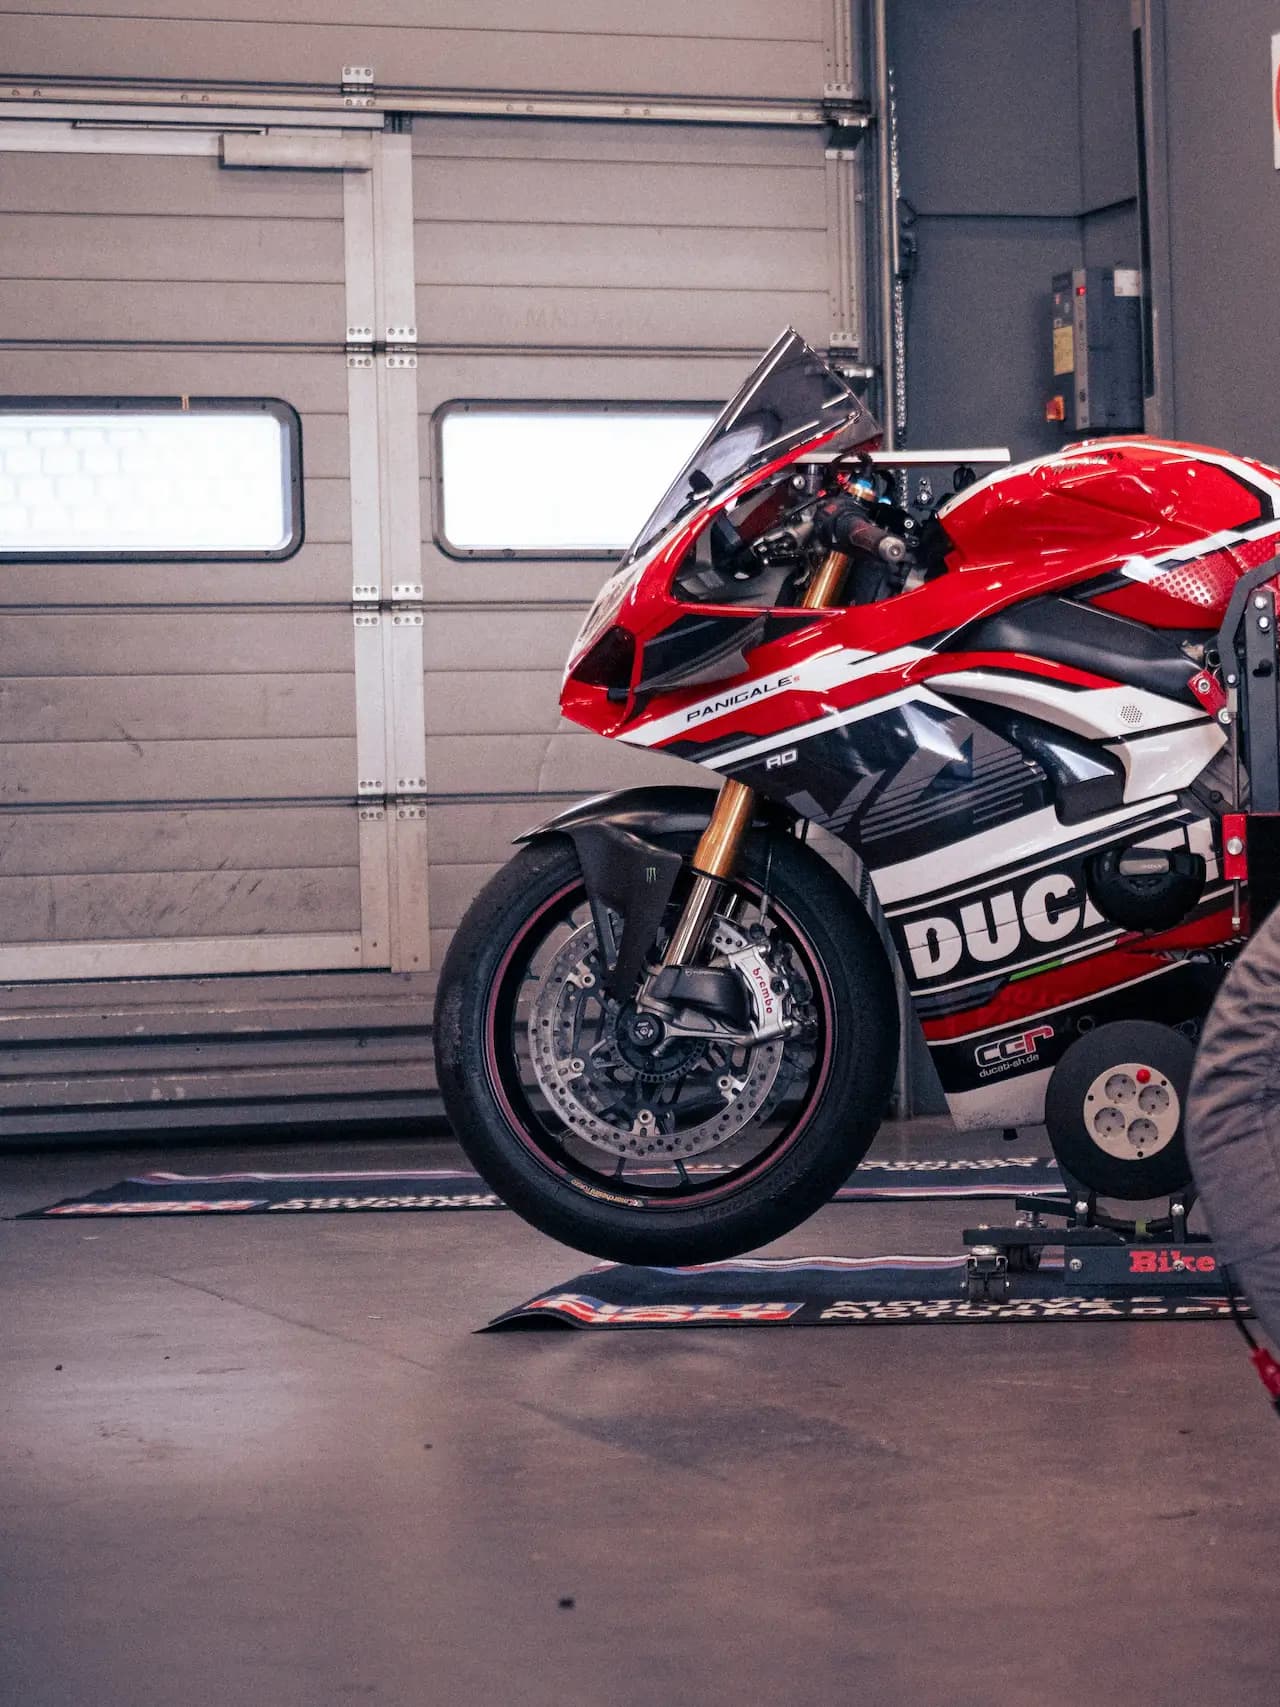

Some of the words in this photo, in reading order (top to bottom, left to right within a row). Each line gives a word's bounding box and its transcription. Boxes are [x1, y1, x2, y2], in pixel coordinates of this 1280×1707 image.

[685, 675, 794, 723] PANIGALE
[752, 967, 774, 1015] brembo
[978, 1053, 1040, 1079] ducati-sh.de
[1129, 1249, 1216, 1273] Bike
